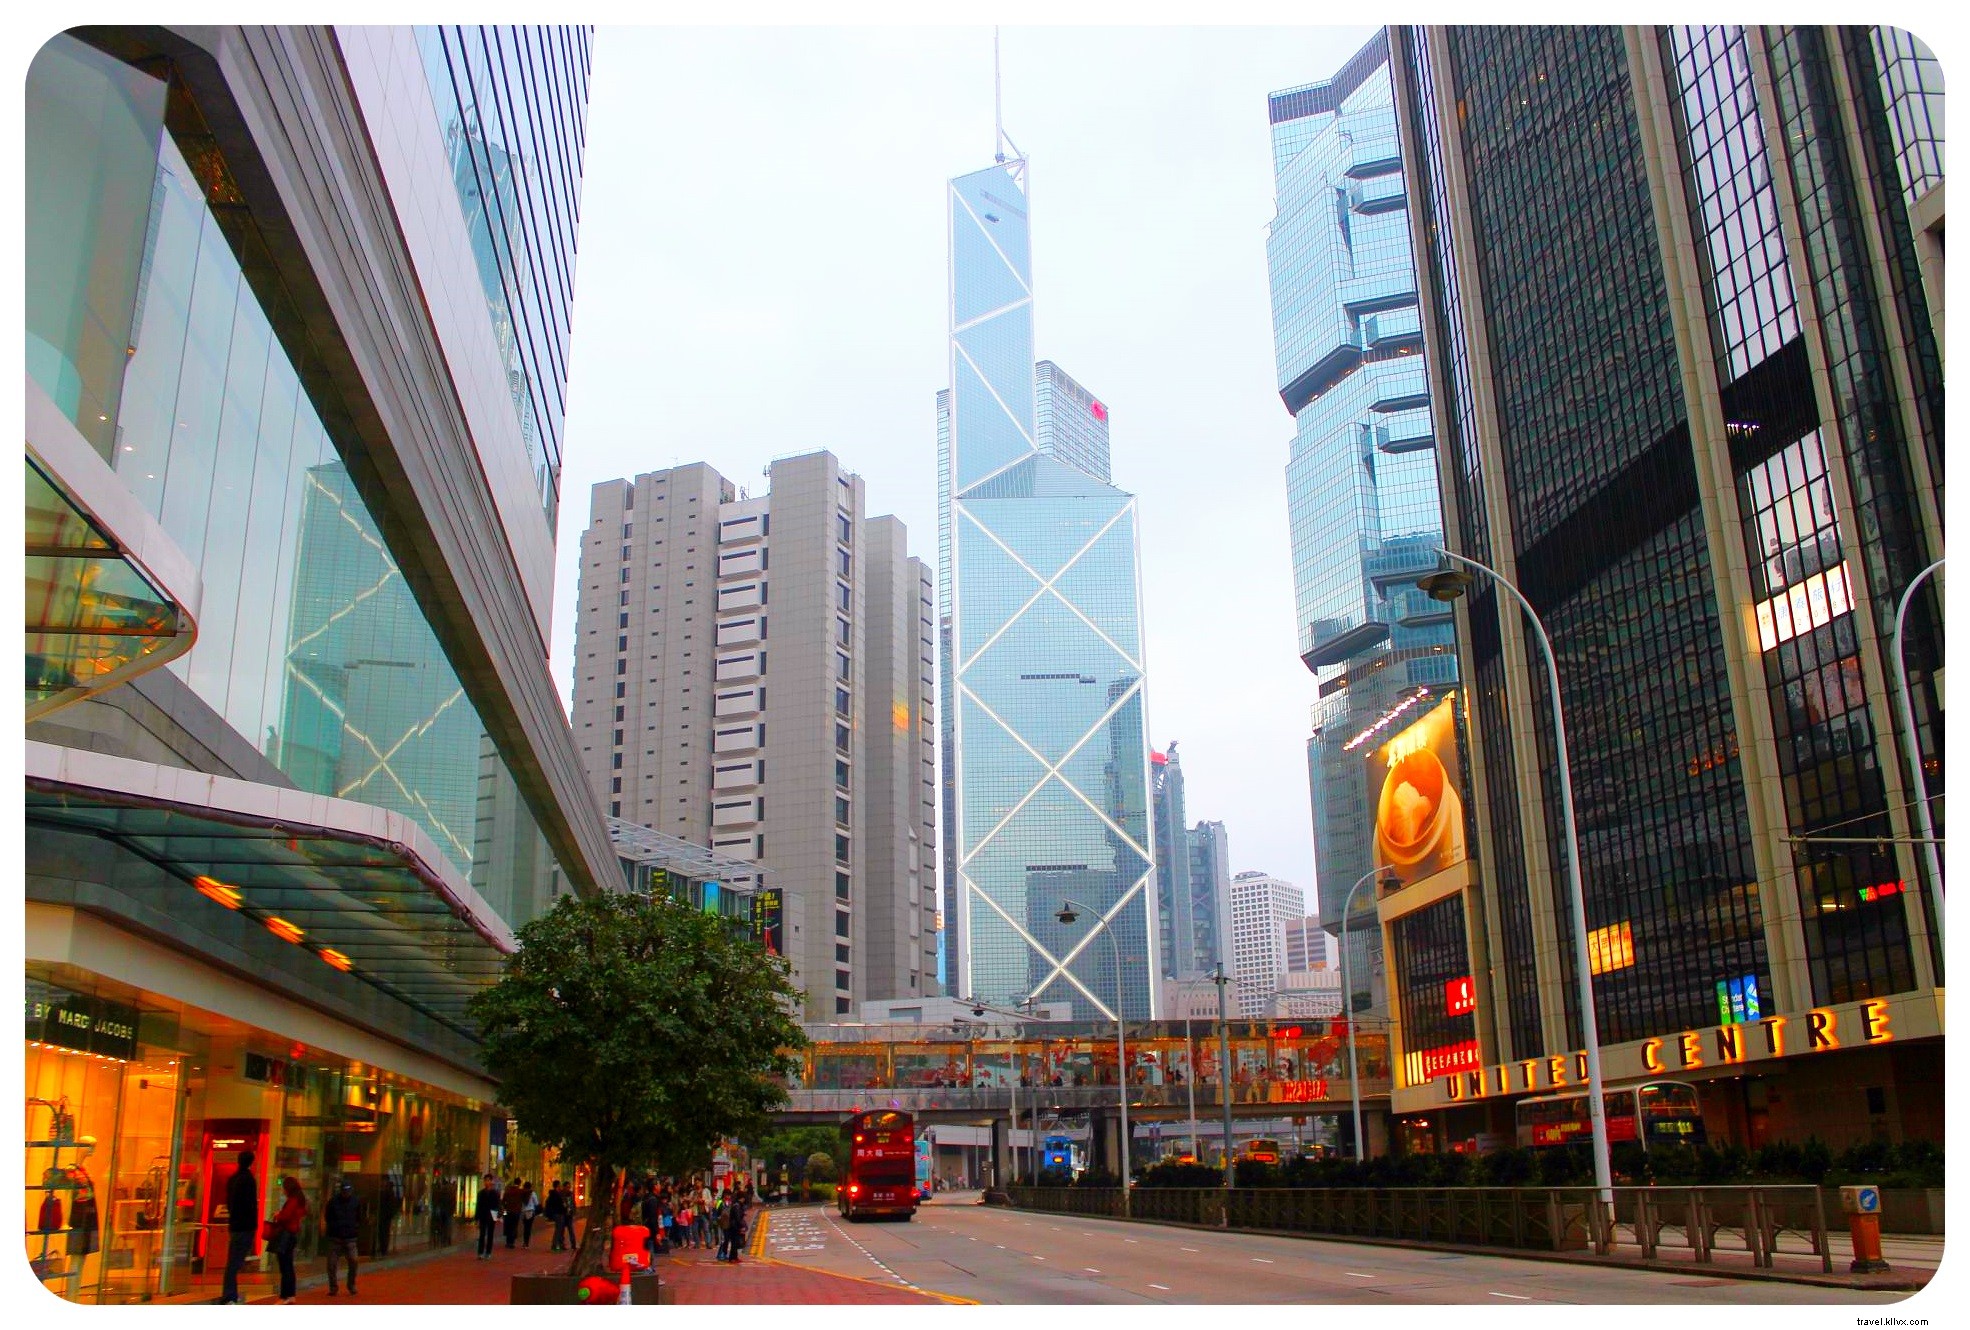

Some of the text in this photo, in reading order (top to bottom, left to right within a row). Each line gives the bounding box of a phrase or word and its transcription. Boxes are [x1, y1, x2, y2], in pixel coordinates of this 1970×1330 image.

[34, 1003, 134, 1040] BY MARC JACOBS
[1446, 1051, 1590, 1101] UNITED
[1641, 998, 1893, 1074] CENTRE
